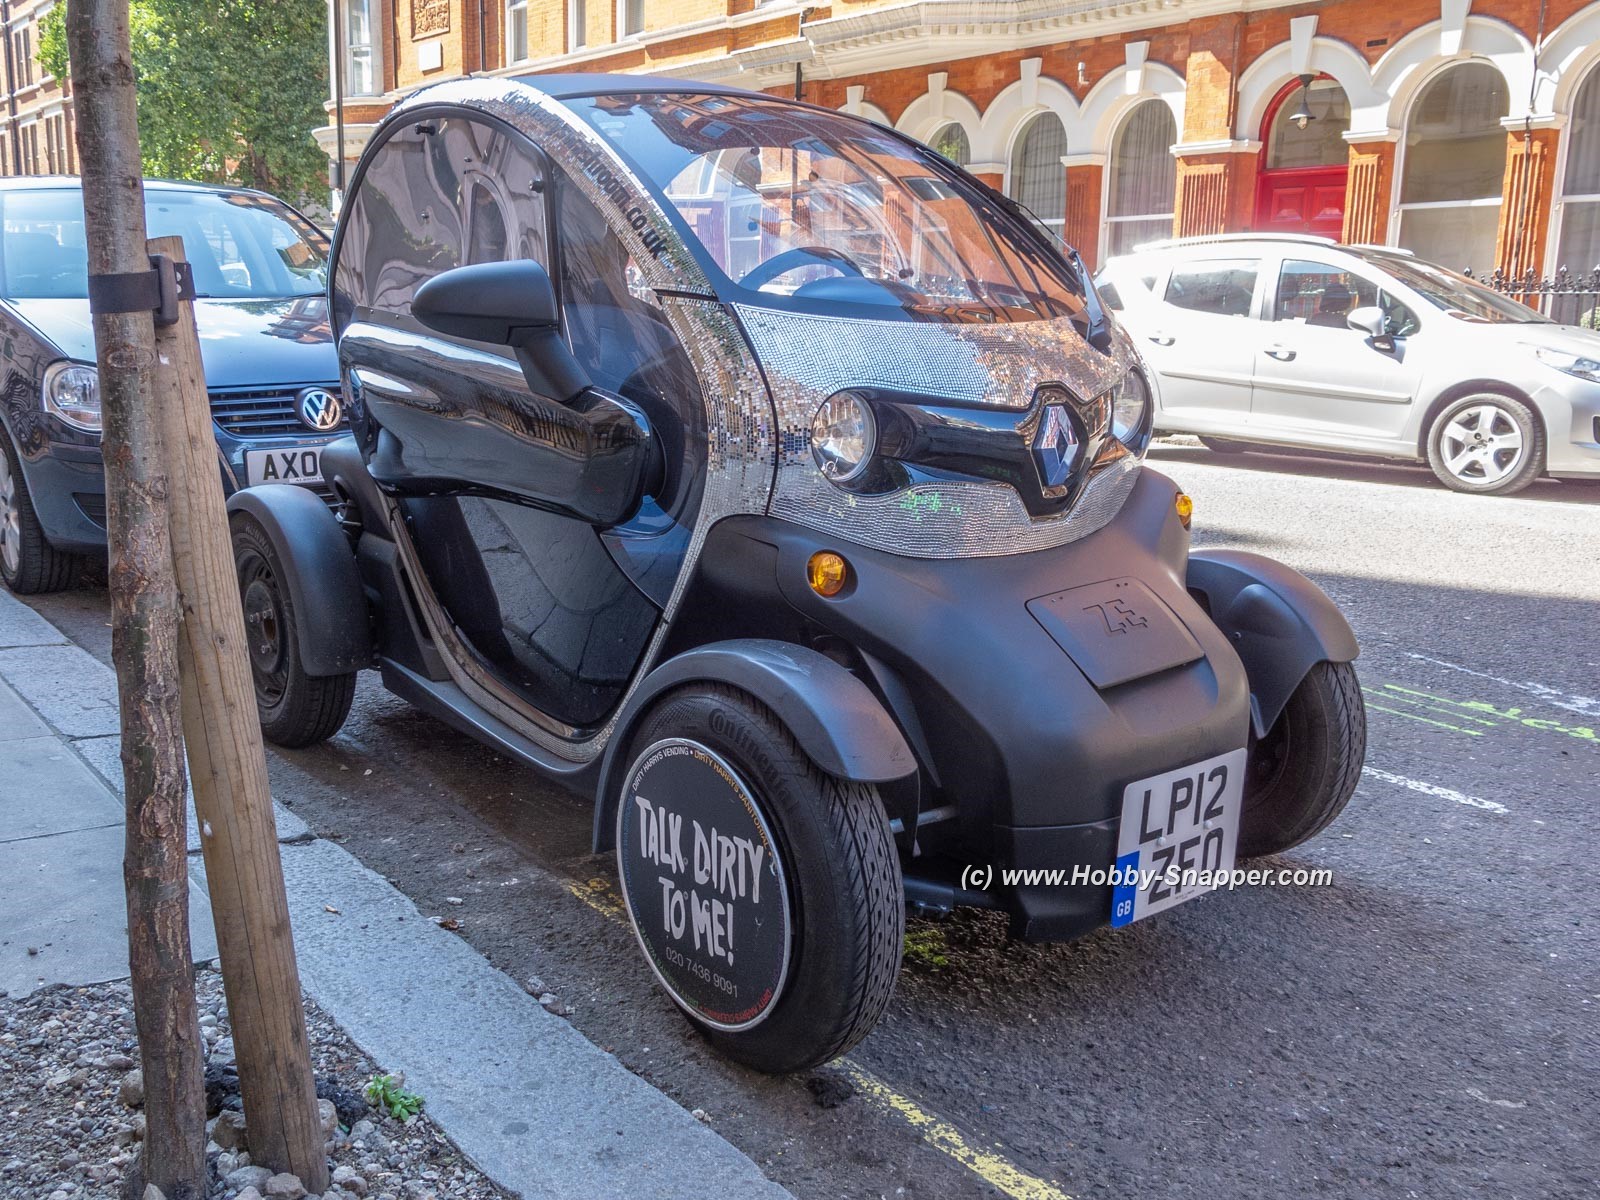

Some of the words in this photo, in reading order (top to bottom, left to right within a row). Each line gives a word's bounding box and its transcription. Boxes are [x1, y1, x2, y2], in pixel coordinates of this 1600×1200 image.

[245, 524, 275, 558] RUNWAY
[632, 769, 645, 791] DIRTY
[642, 751, 664, 772] HARRYS
[663, 746, 689, 757] VENDING
[694, 750, 713, 767] DIRTY
[713, 762, 739, 793] HARRYS
[739, 793, 769, 849] JANITORIAL
[1138, 764, 1229, 845] LP12
[635, 795, 685, 874] TALK
[692, 819, 764, 904] DIRTY
[658, 876, 686, 940] TO
[691, 889, 734, 967] ME!
[1116, 899, 1132, 918] GB
[665, 946, 684, 967] 020
[686, 957, 711, 983] 7436
[713, 973, 738, 998] 9091
